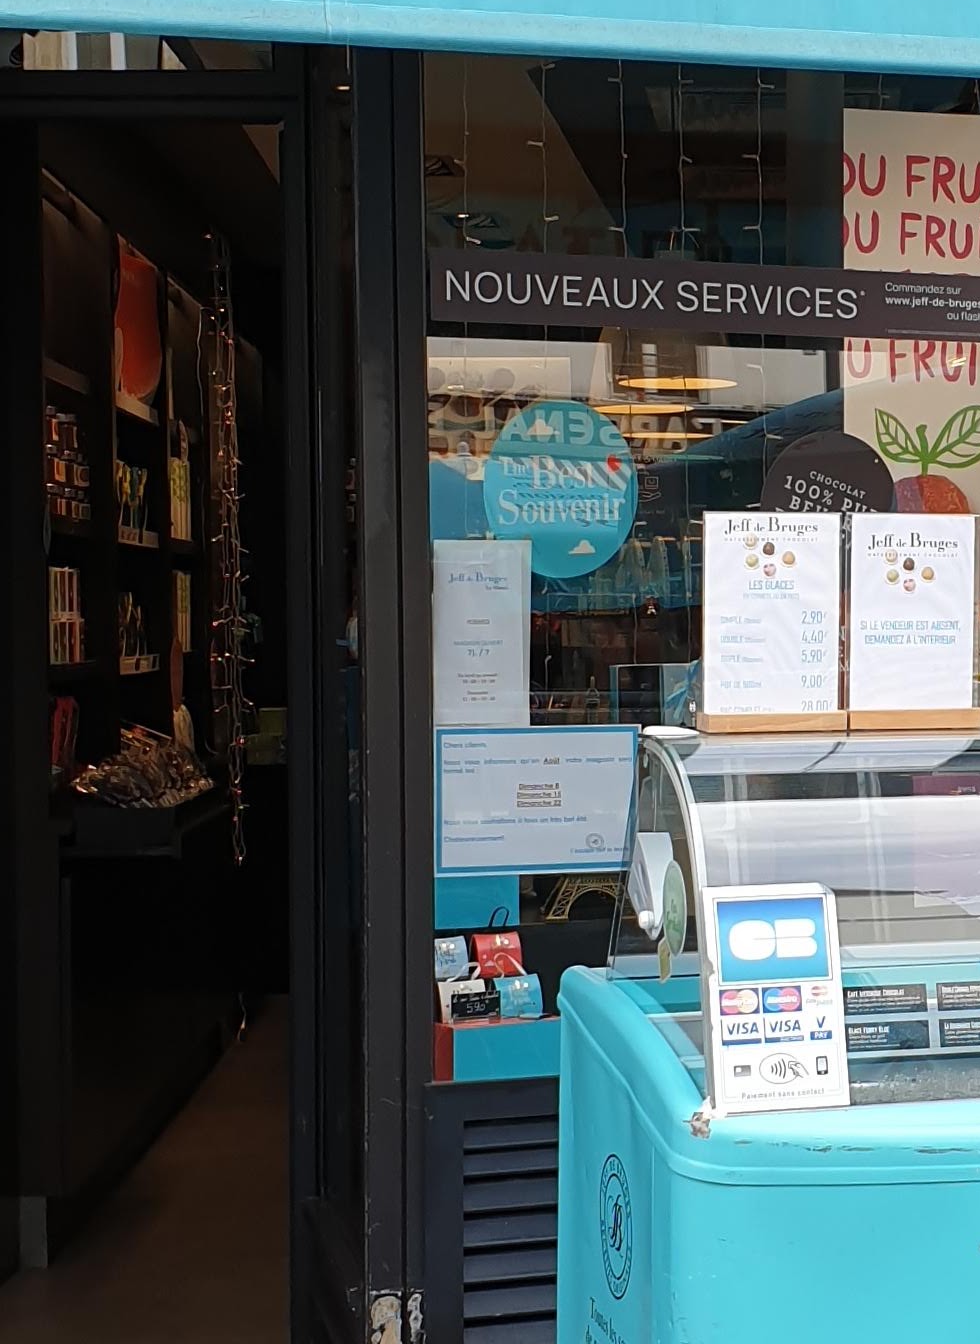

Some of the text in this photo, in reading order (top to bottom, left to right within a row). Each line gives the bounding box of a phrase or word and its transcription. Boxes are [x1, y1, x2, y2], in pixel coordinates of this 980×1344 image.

[844, 209, 880, 254] U
[445, 269, 664, 312] NOUVEAUX
[885, 282, 962, 295] Commandez sur
[946, 312, 960, 321] ou
[784, 475, 834, 506] 100%
[809, 470, 866, 500] CHOCOLAT
[498, 489, 626, 526] Souvenir
[724, 516, 819, 536] Jeff de Bruges
[867, 532, 959, 553] Jeff de Bruges
[748, 580, 795, 590] LES GLACES
[860, 620, 868, 631] SI
[869, 620, 878, 631] LE
[880, 620, 914, 631] VENDEUR
[915, 620, 929, 631] EST
[864, 635, 905, 645] DEMANDEZ
[518, 783, 554, 791] Dimanche
[726, 1021, 760, 1036] VISA
[769, 1019, 802, 1033] VISA
[741, 1088, 825, 1101] Paiement sans contact
[589, 1296, 609, 1336] Toutes
